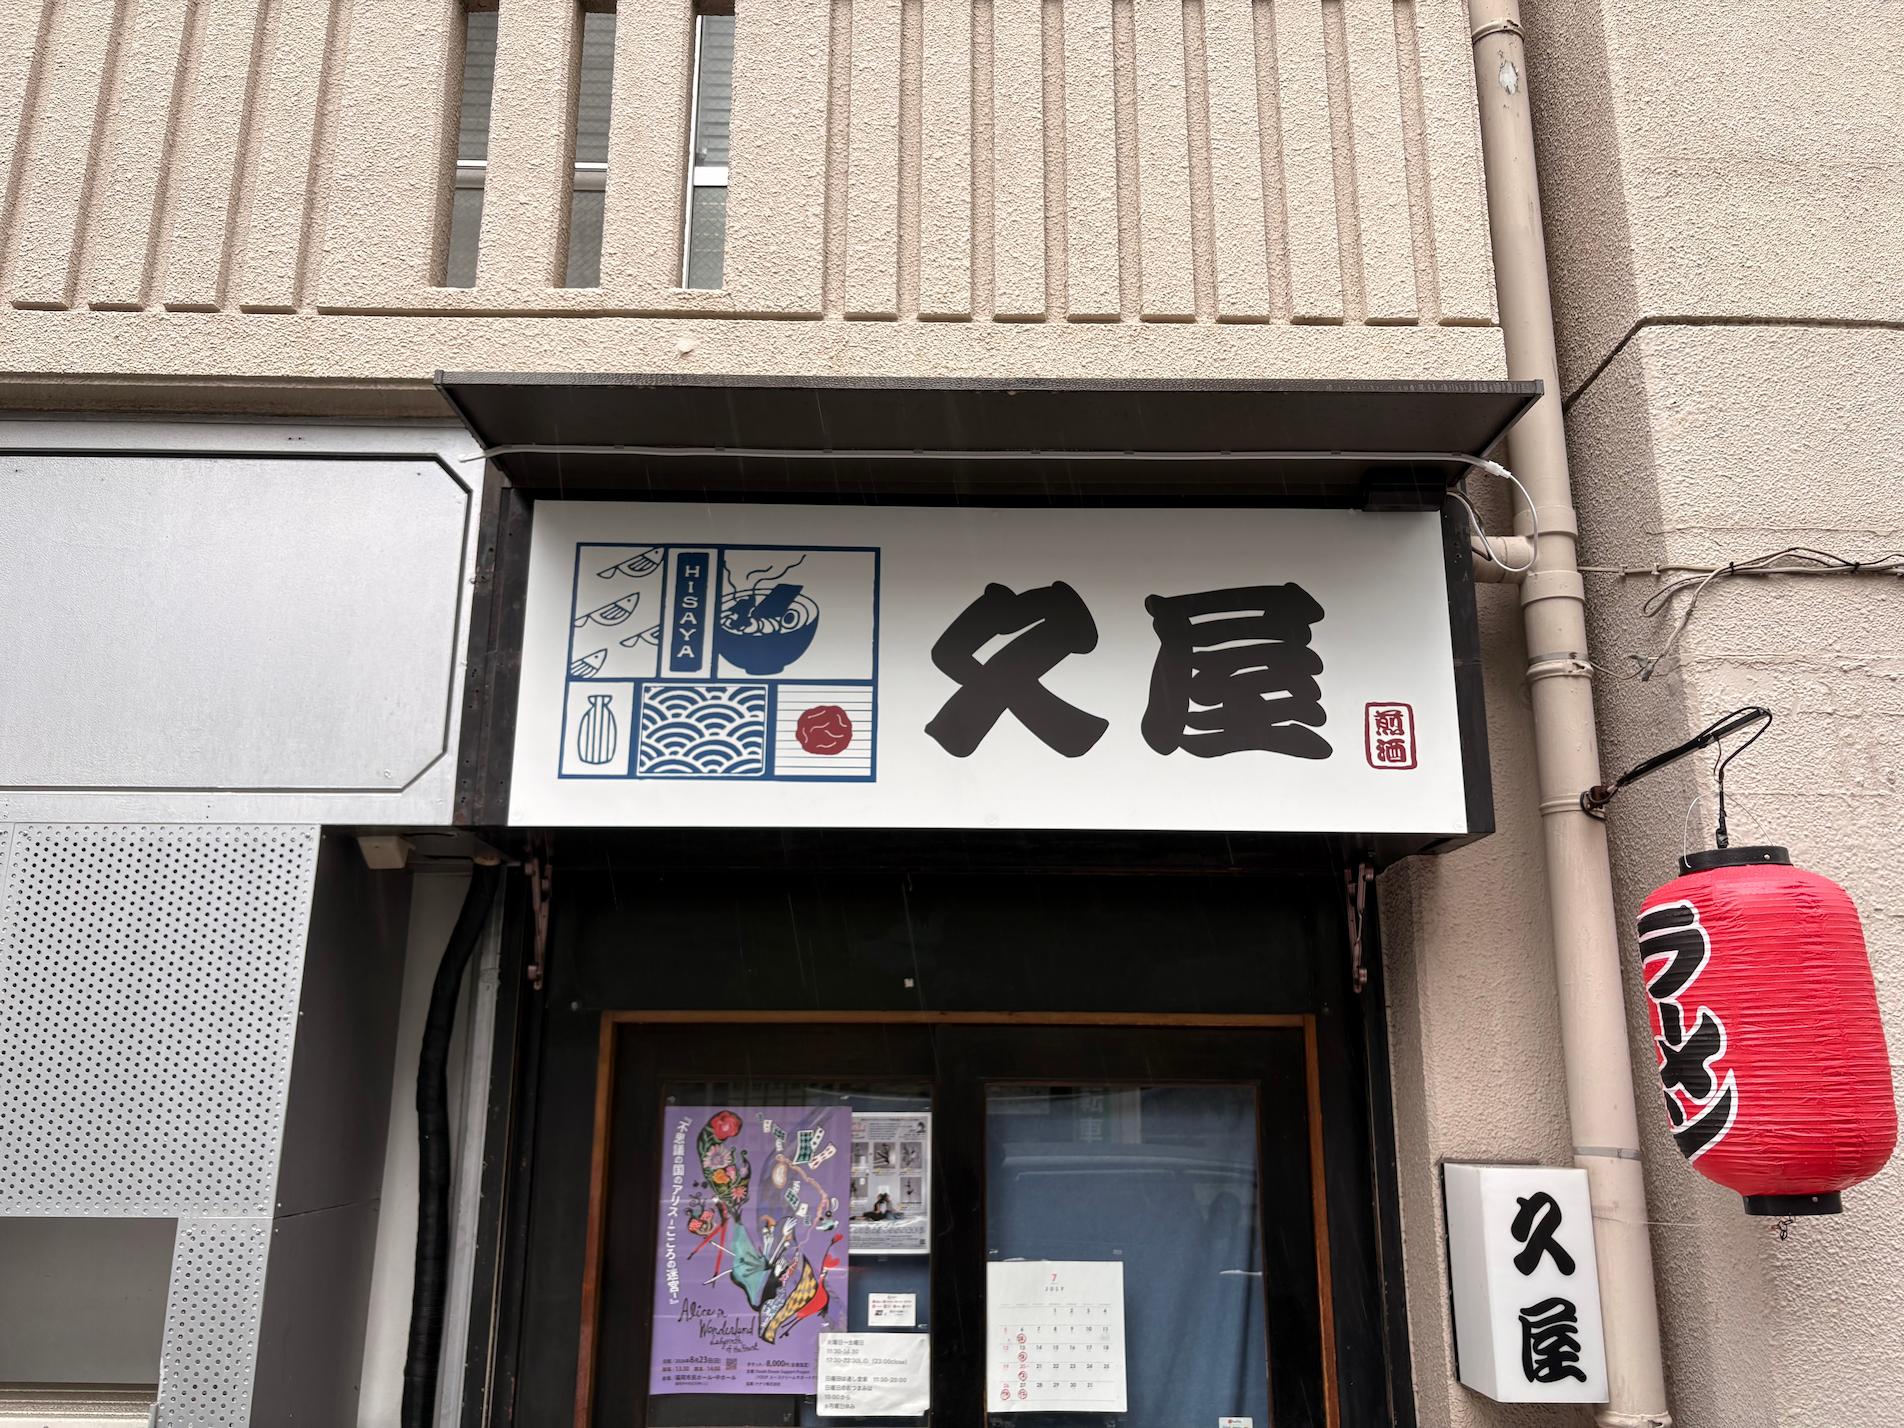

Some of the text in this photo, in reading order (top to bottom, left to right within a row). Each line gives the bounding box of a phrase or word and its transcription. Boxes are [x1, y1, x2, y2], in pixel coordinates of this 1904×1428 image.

[676, 565, 701, 659] HISAYA
[925, 580, 1333, 760] 久屋
[1637, 899, 1739, 1162] ラーメン
[677, 1297, 715, 1322] Alice
[699, 1315, 756, 1338] Wonderland
[1511, 1191, 1587, 1383] 久屋
